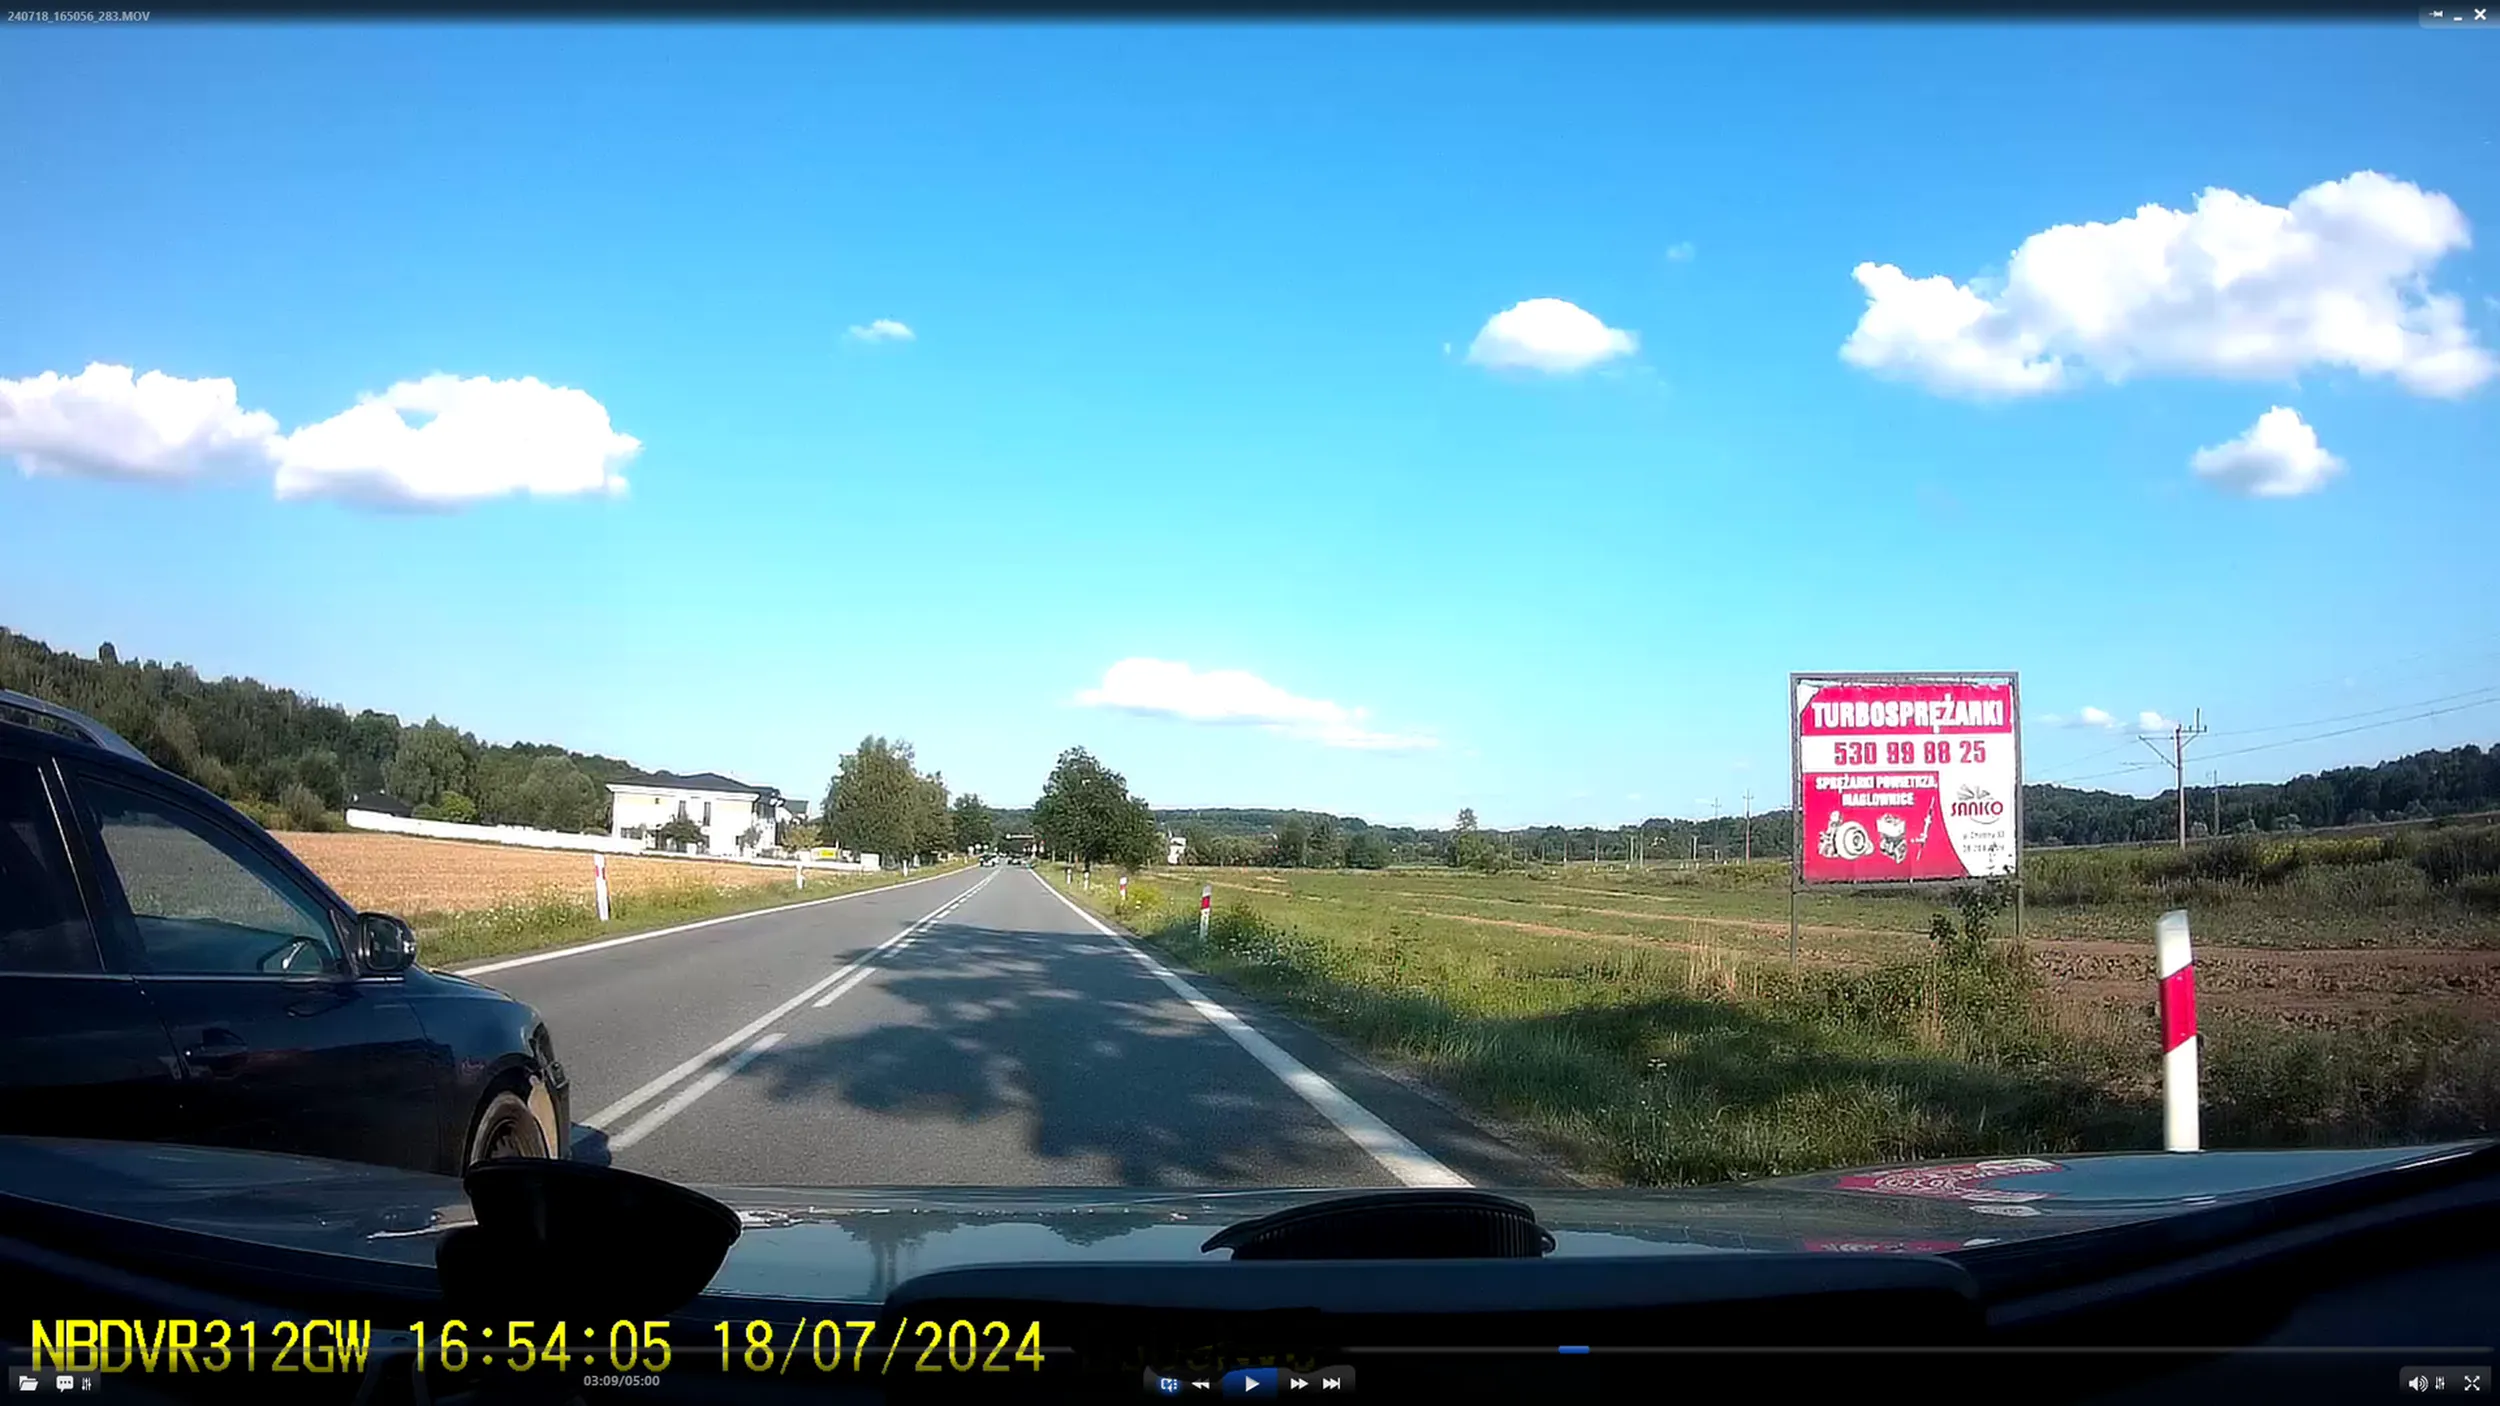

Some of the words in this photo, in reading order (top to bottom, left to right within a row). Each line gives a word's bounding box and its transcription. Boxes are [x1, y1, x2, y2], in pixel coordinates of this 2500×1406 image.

[1811, 693, 2005, 734] TURBOSPRĘŻARKI
[1834, 741, 1878, 766] 530
[1959, 740, 1987, 763] 25
[1950, 801, 2004, 817] SANKO
